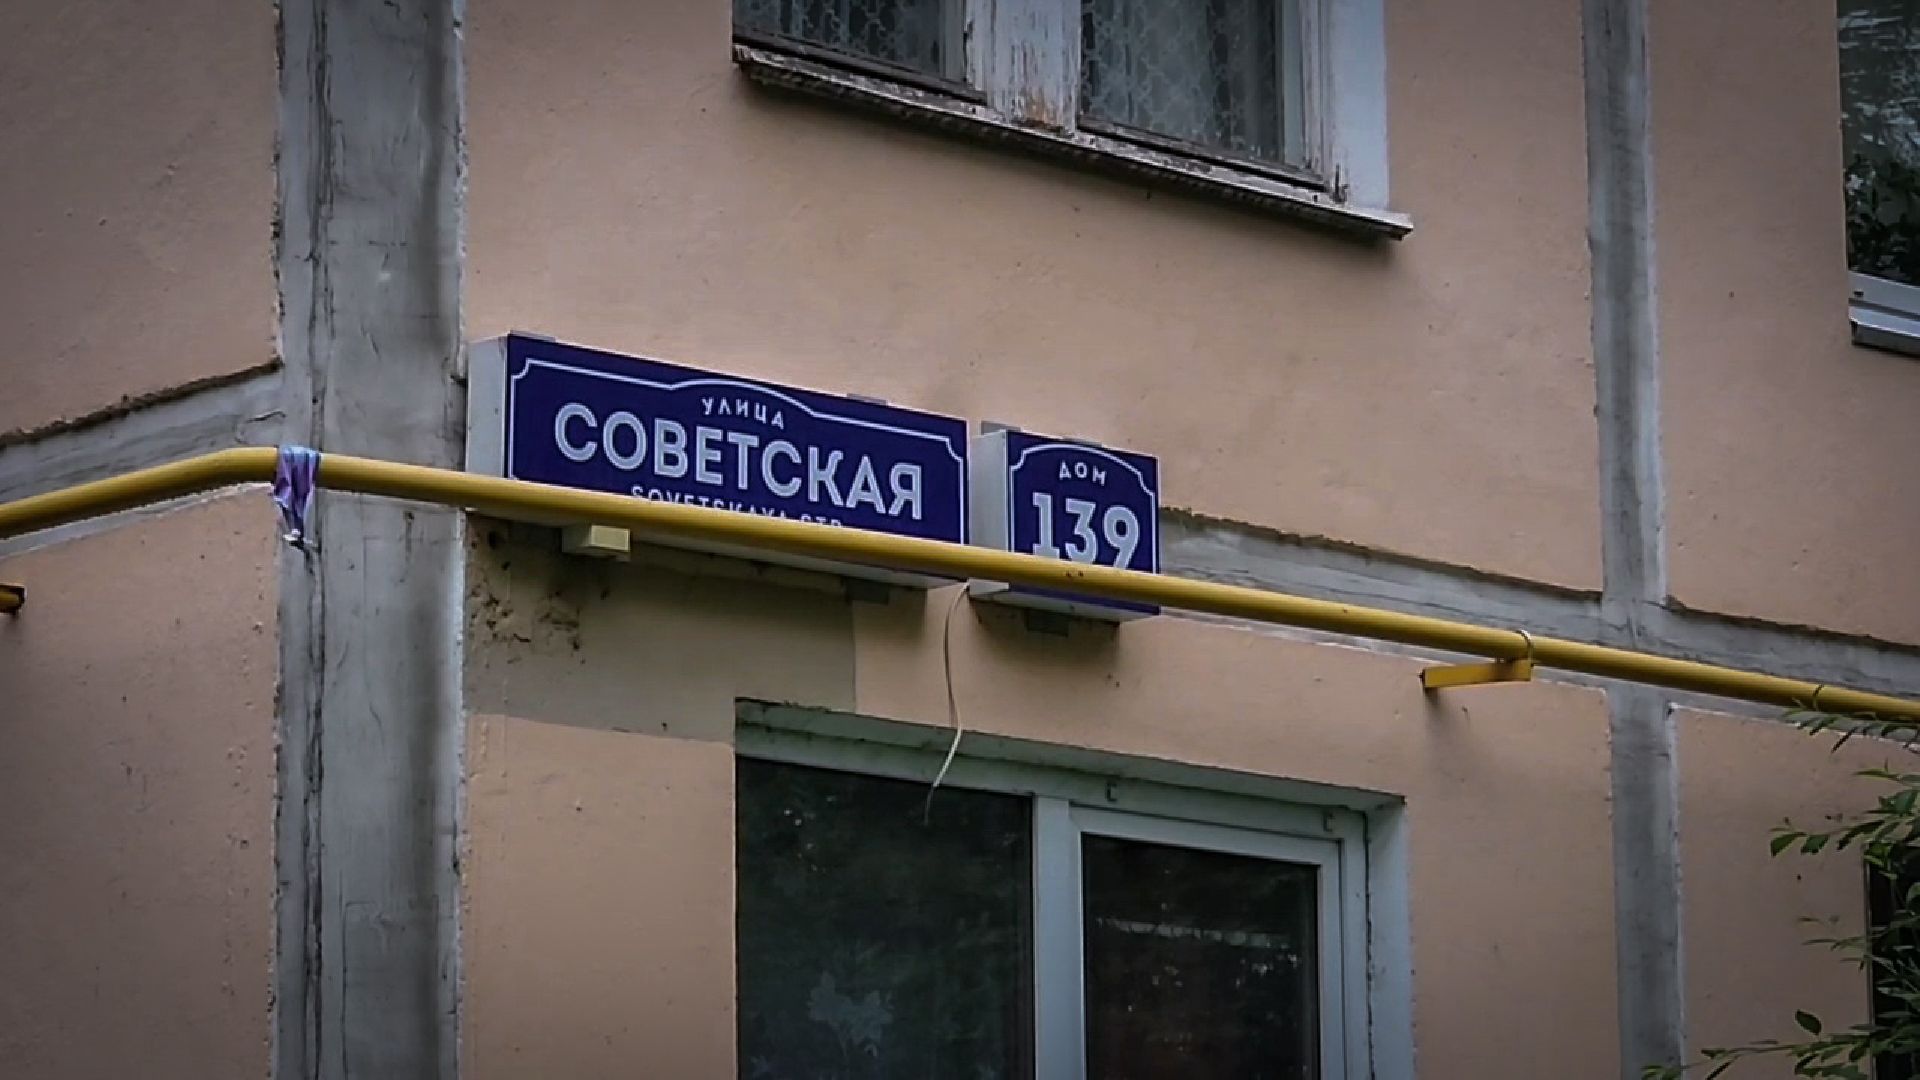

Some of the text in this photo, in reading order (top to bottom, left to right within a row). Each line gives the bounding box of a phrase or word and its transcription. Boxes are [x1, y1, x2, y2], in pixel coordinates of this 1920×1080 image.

[702, 397, 784, 430] УЛИЦА
[554, 402, 923, 521] СОВЕТСКАЯ
[1059, 460, 1107, 486] ДОМ
[1032, 492, 1140, 570] 139
